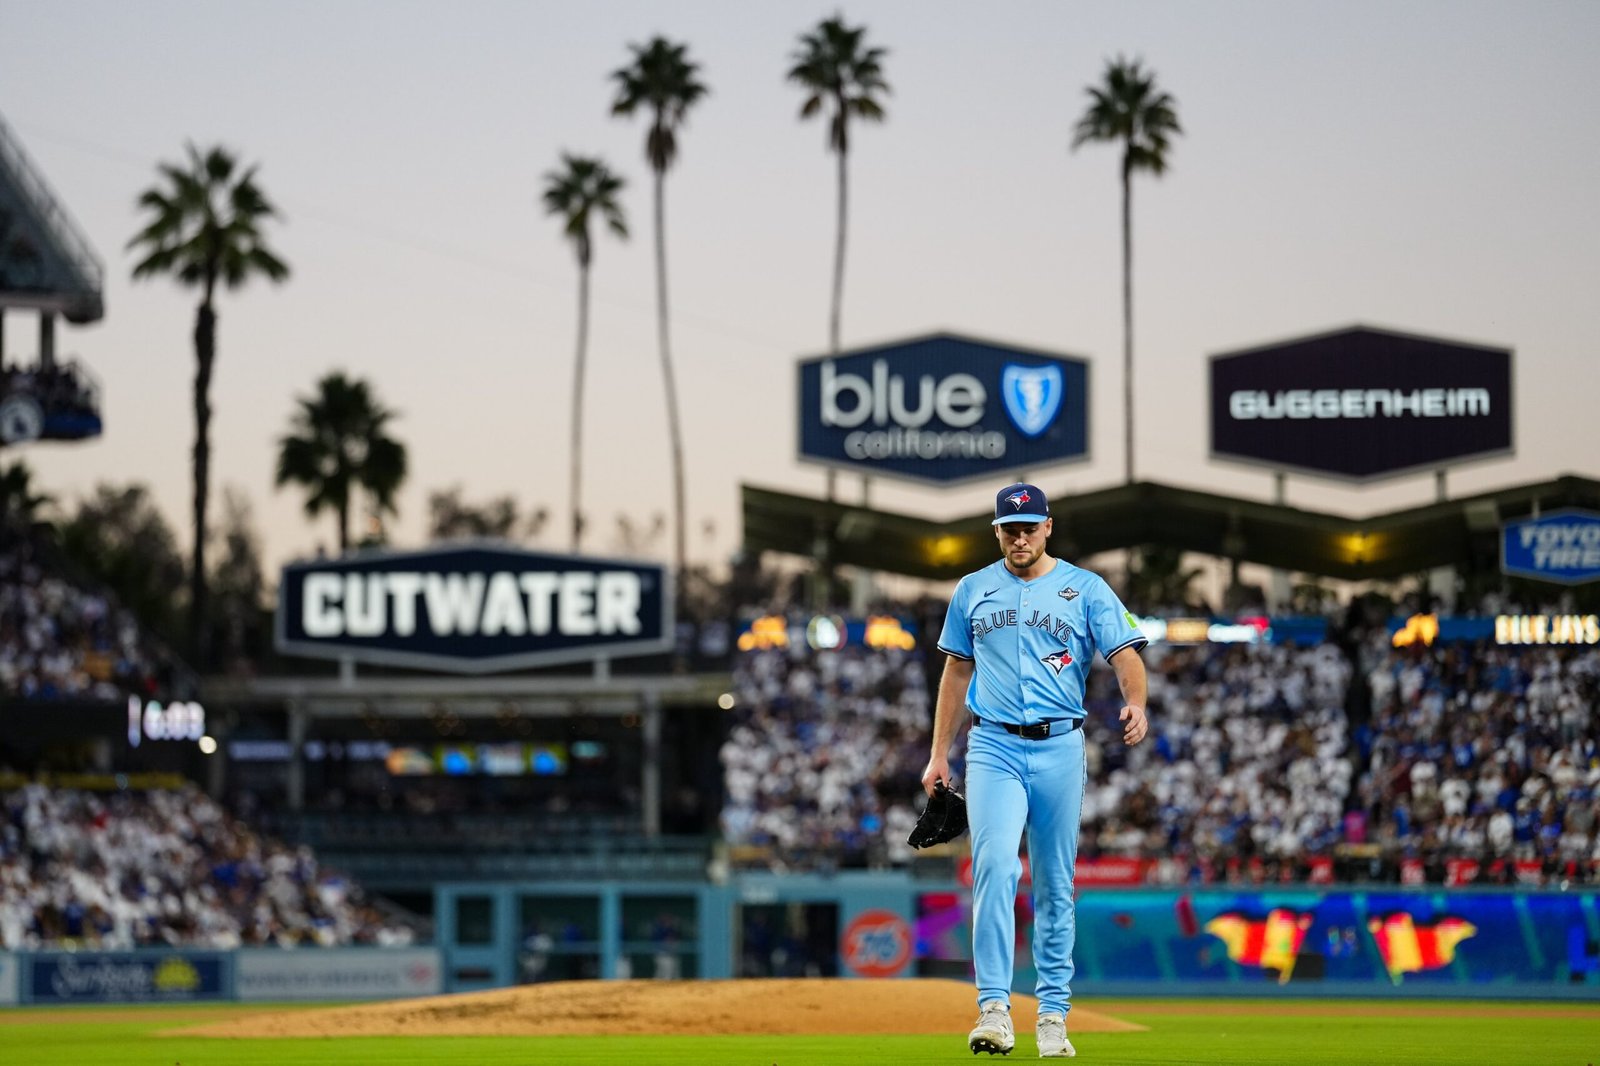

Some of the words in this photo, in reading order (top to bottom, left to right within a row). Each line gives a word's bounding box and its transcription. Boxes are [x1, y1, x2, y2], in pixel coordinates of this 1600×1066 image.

[820, 359, 986, 428] blue
[1229, 388, 1490, 420] GUGGENHEIM
[844, 427, 1006, 460] california
[1518, 523, 1600, 549] TOYO
[302, 571, 642, 638] CUTWATER
[973, 609, 1017, 641] BLUE
[1024, 609, 1072, 643] JAYS
[1495, 614, 1548, 645] BLUE
[1549, 614, 1600, 645] JAYS
